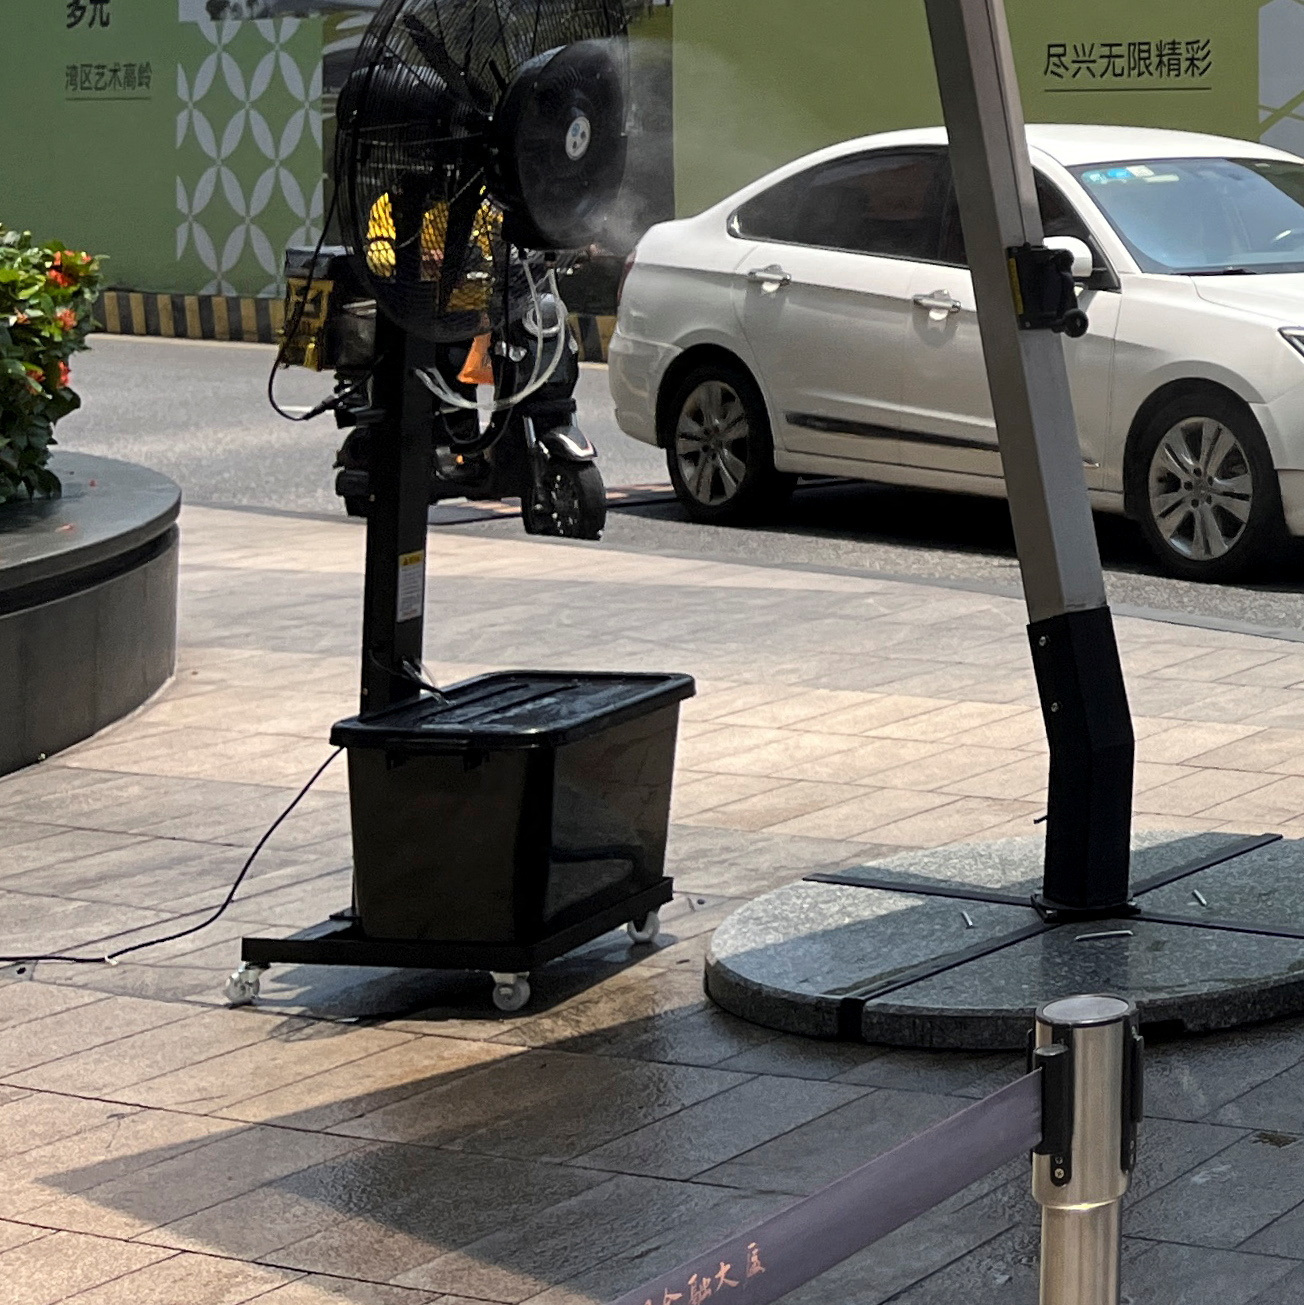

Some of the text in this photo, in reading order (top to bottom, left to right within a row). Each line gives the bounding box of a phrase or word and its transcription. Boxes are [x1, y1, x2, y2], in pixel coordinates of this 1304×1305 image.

[1044, 38, 1213, 79] 尽兴无限精彩
